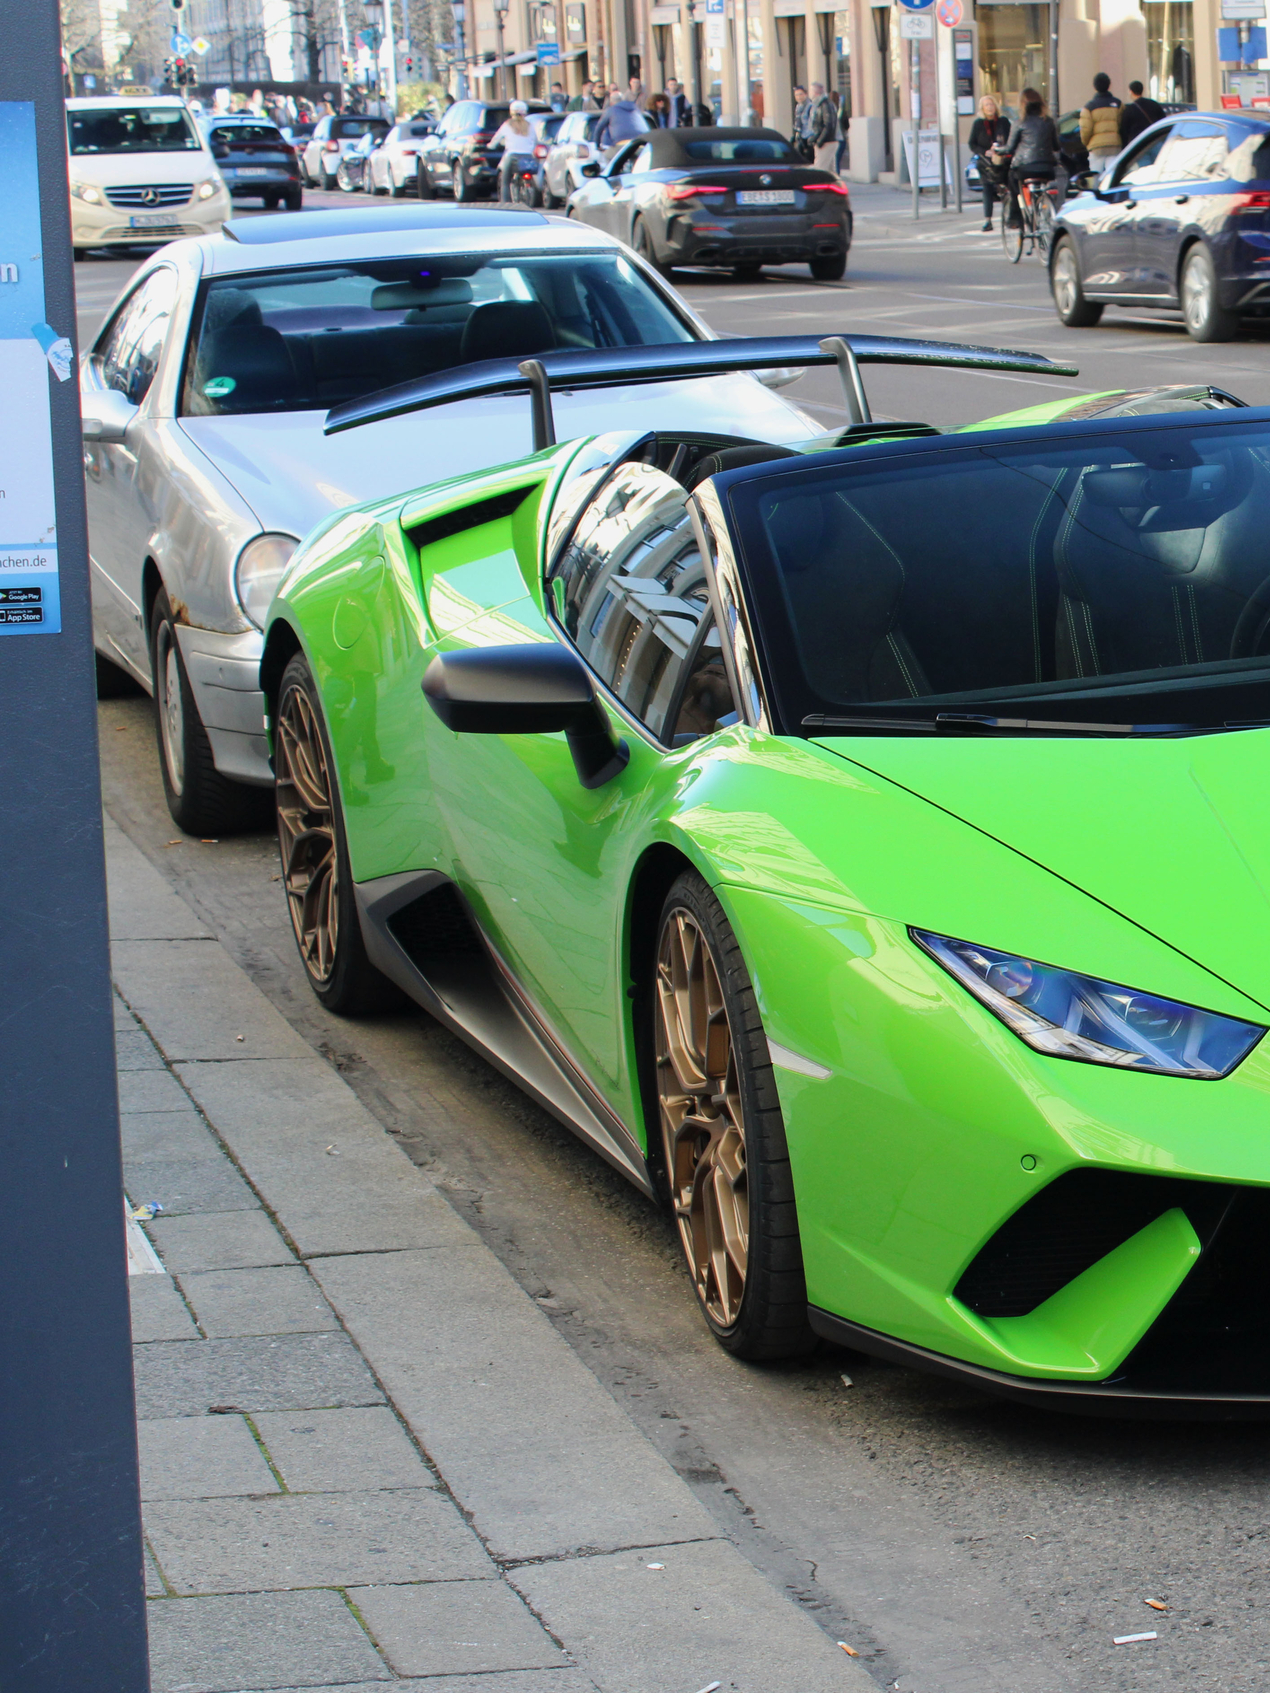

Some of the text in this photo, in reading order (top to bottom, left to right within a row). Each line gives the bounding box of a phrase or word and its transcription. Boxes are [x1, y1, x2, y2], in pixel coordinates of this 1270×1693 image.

[0, 554, 47, 568] chen.de
[7, 613, 41, 623] App Store
